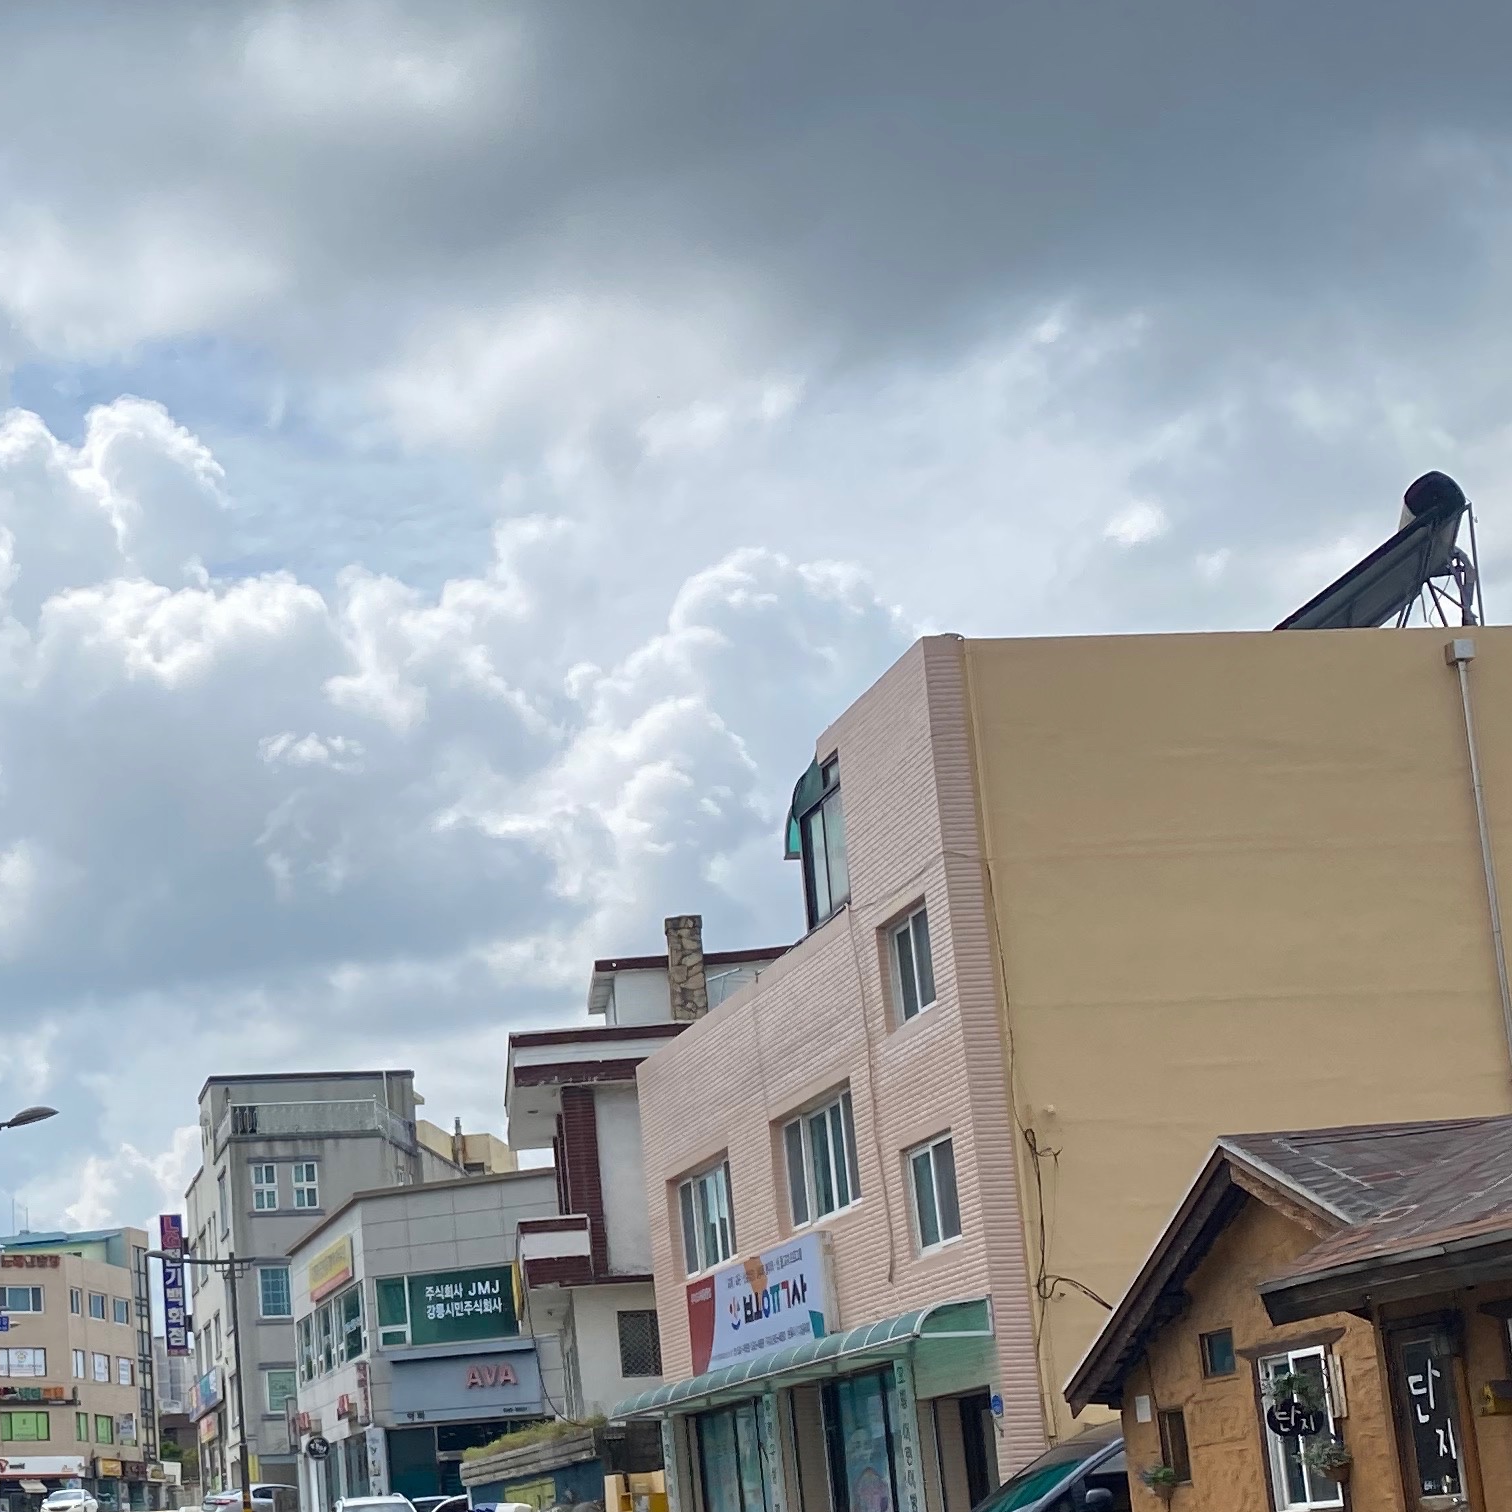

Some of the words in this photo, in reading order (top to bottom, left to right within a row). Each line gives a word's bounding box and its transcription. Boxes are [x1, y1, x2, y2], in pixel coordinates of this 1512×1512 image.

[425, 1282, 463, 1301] 주식회사
[468, 1280, 500, 1297] JMJ
[426, 1297, 503, 1320] 강릉시민주식회사
[466, 1362, 519, 1389] AVA
